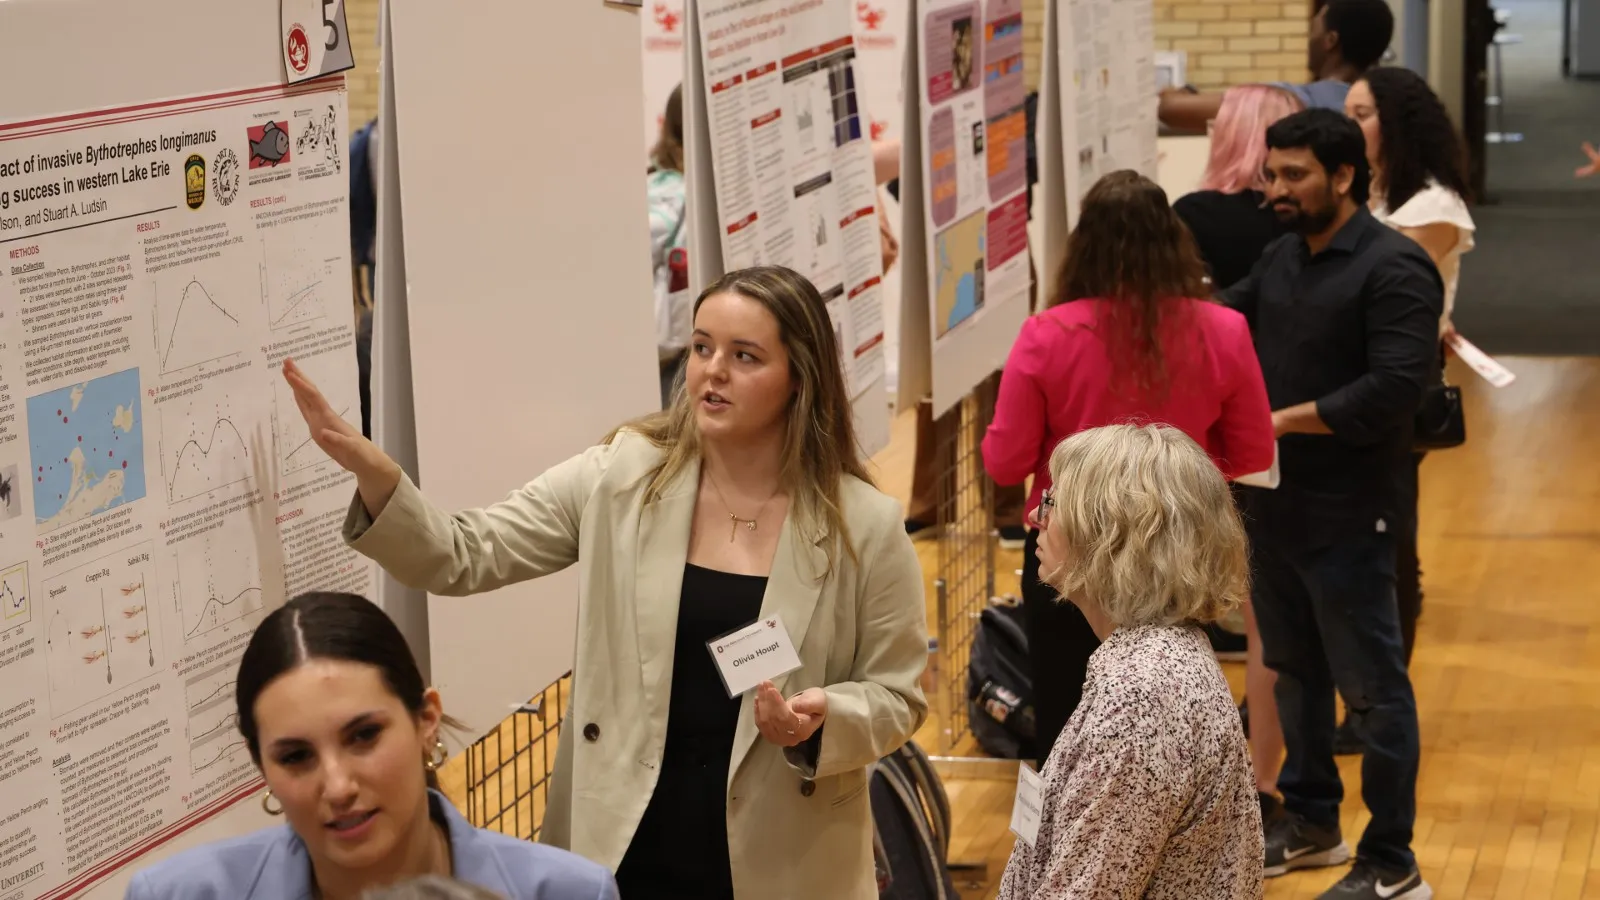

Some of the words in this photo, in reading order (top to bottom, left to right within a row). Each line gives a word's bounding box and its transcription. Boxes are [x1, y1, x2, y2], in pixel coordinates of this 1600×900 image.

[322, 0, 339, 50] 5
[24, 155, 34, 173] of
[38, 150, 82, 171] invasive
[86, 138, 157, 165] Bythotrephes
[160, 130, 216, 152] longimanus
[14, 182, 60, 203] success
[64, 177, 74, 194] in
[77, 172, 118, 191] western
[122, 166, 147, 184] Lake
[151, 161, 170, 178] Erie
[25, 210, 40, 226] and
[43, 205, 69, 222] Stuart
[70, 203, 79, 217] A.
[81, 198, 107, 215] Ludsin
[250, 197, 272, 208] RESULTS
[137, 220, 160, 233] RESULTS
[10, 245, 40, 259] METHODS
[23, 261, 45, 271] Collection
[733, 654, 754, 667] Olivia
[756, 642, 779, 656] Houpt
[1, 862, 44, 890] UNIVERSITY
